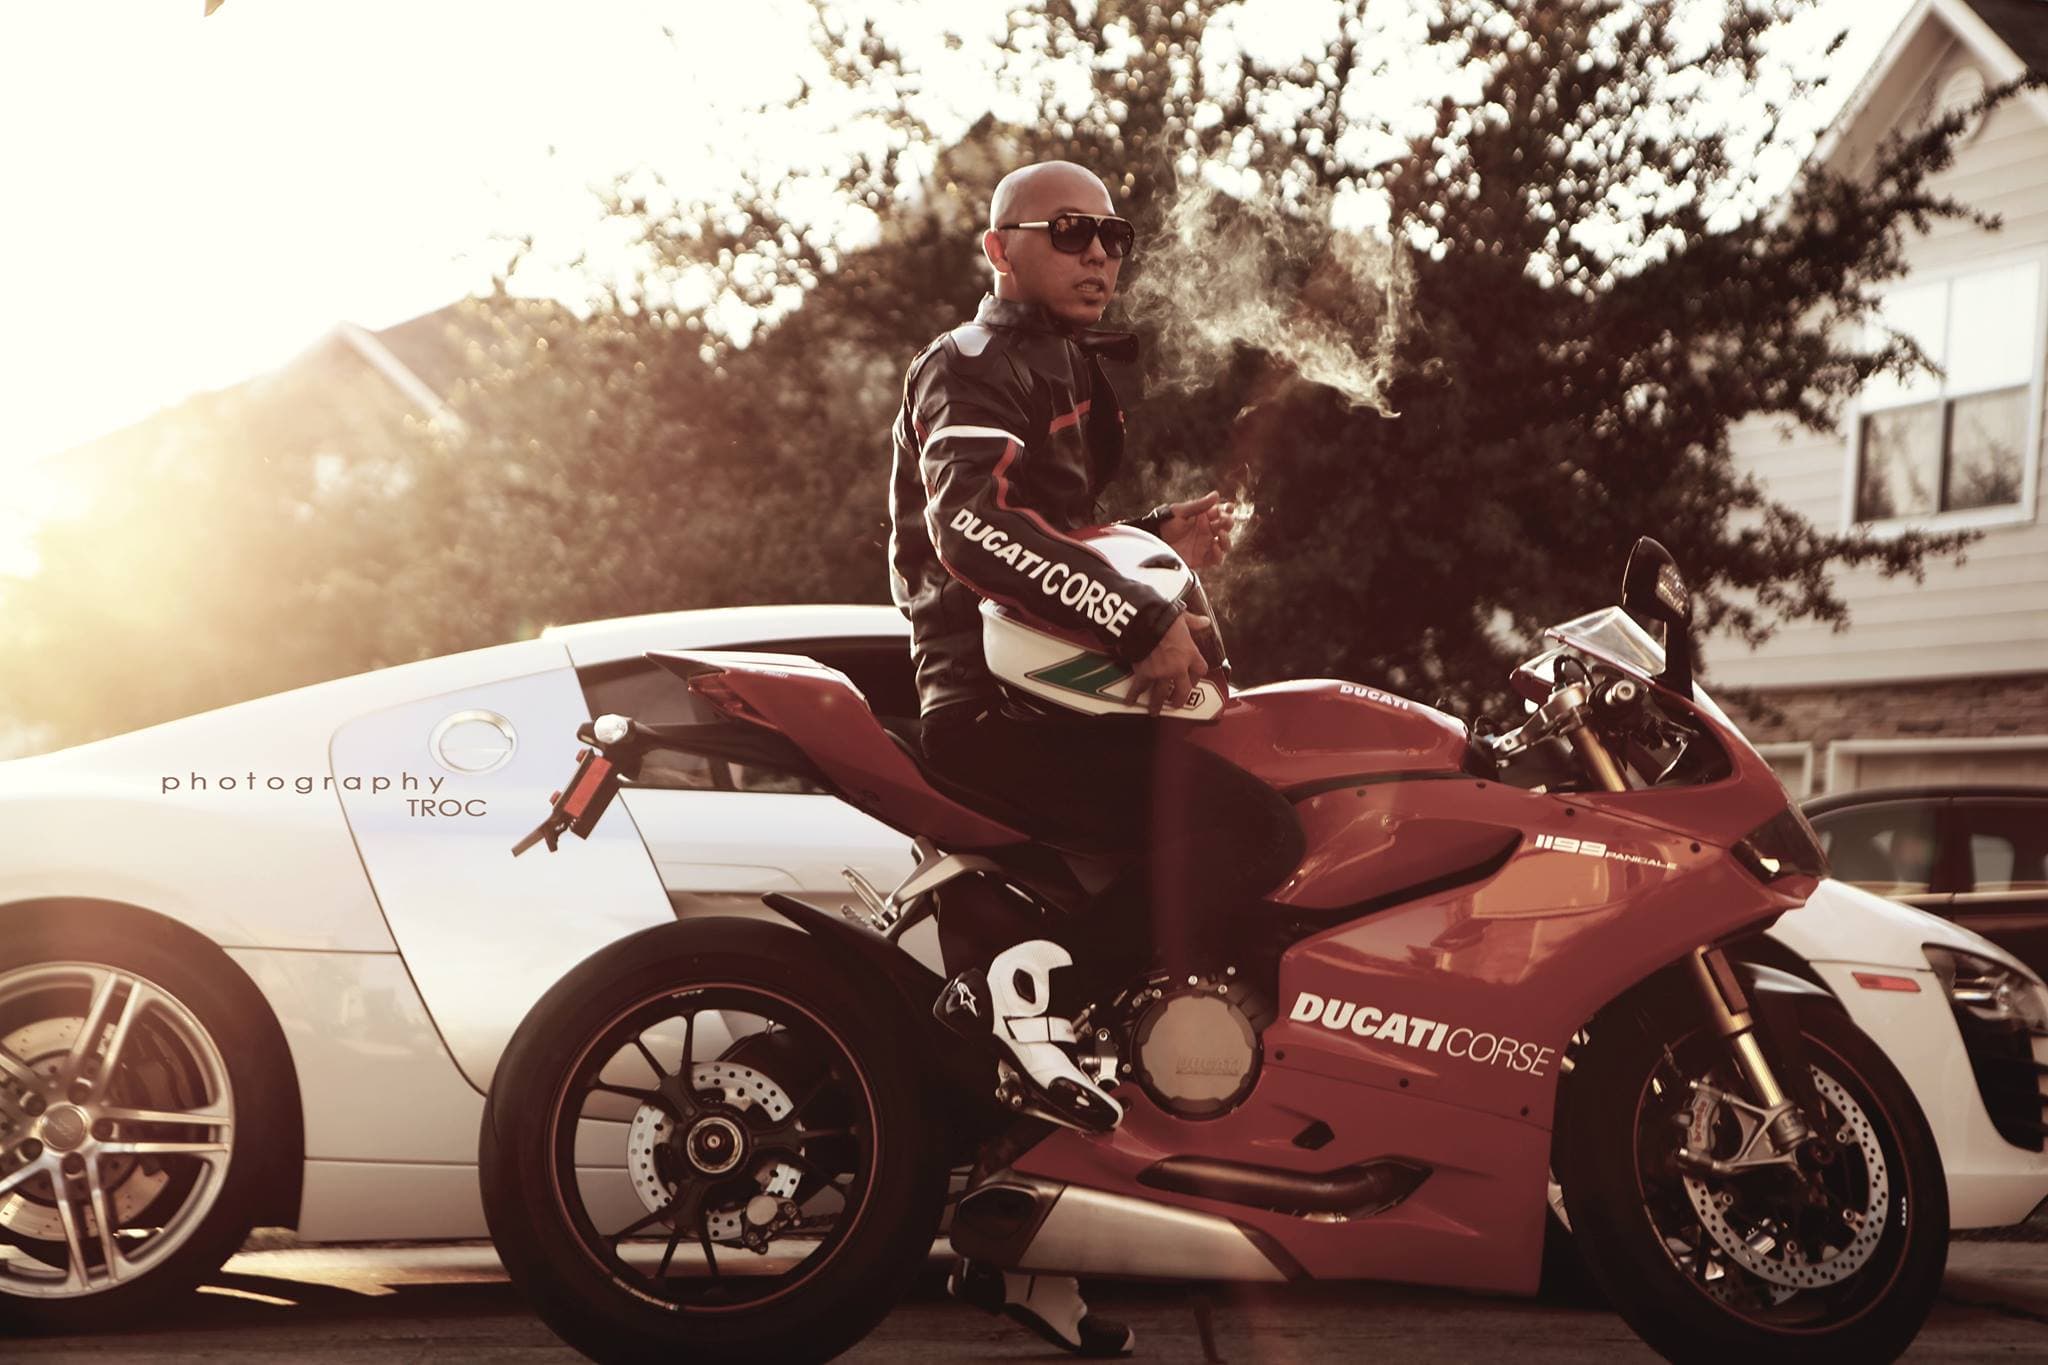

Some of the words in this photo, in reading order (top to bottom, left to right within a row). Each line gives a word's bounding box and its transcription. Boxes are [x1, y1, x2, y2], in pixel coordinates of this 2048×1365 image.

[950, 508, 1050, 580] DUCATI
[1042, 563, 1138, 637] CORSE
[1339, 684, 1409, 711] DUCATI
[1535, 834, 1607, 858] 1199
[1290, 992, 1449, 1052] DUCATI
[1446, 1027, 1556, 1077] CORSE
